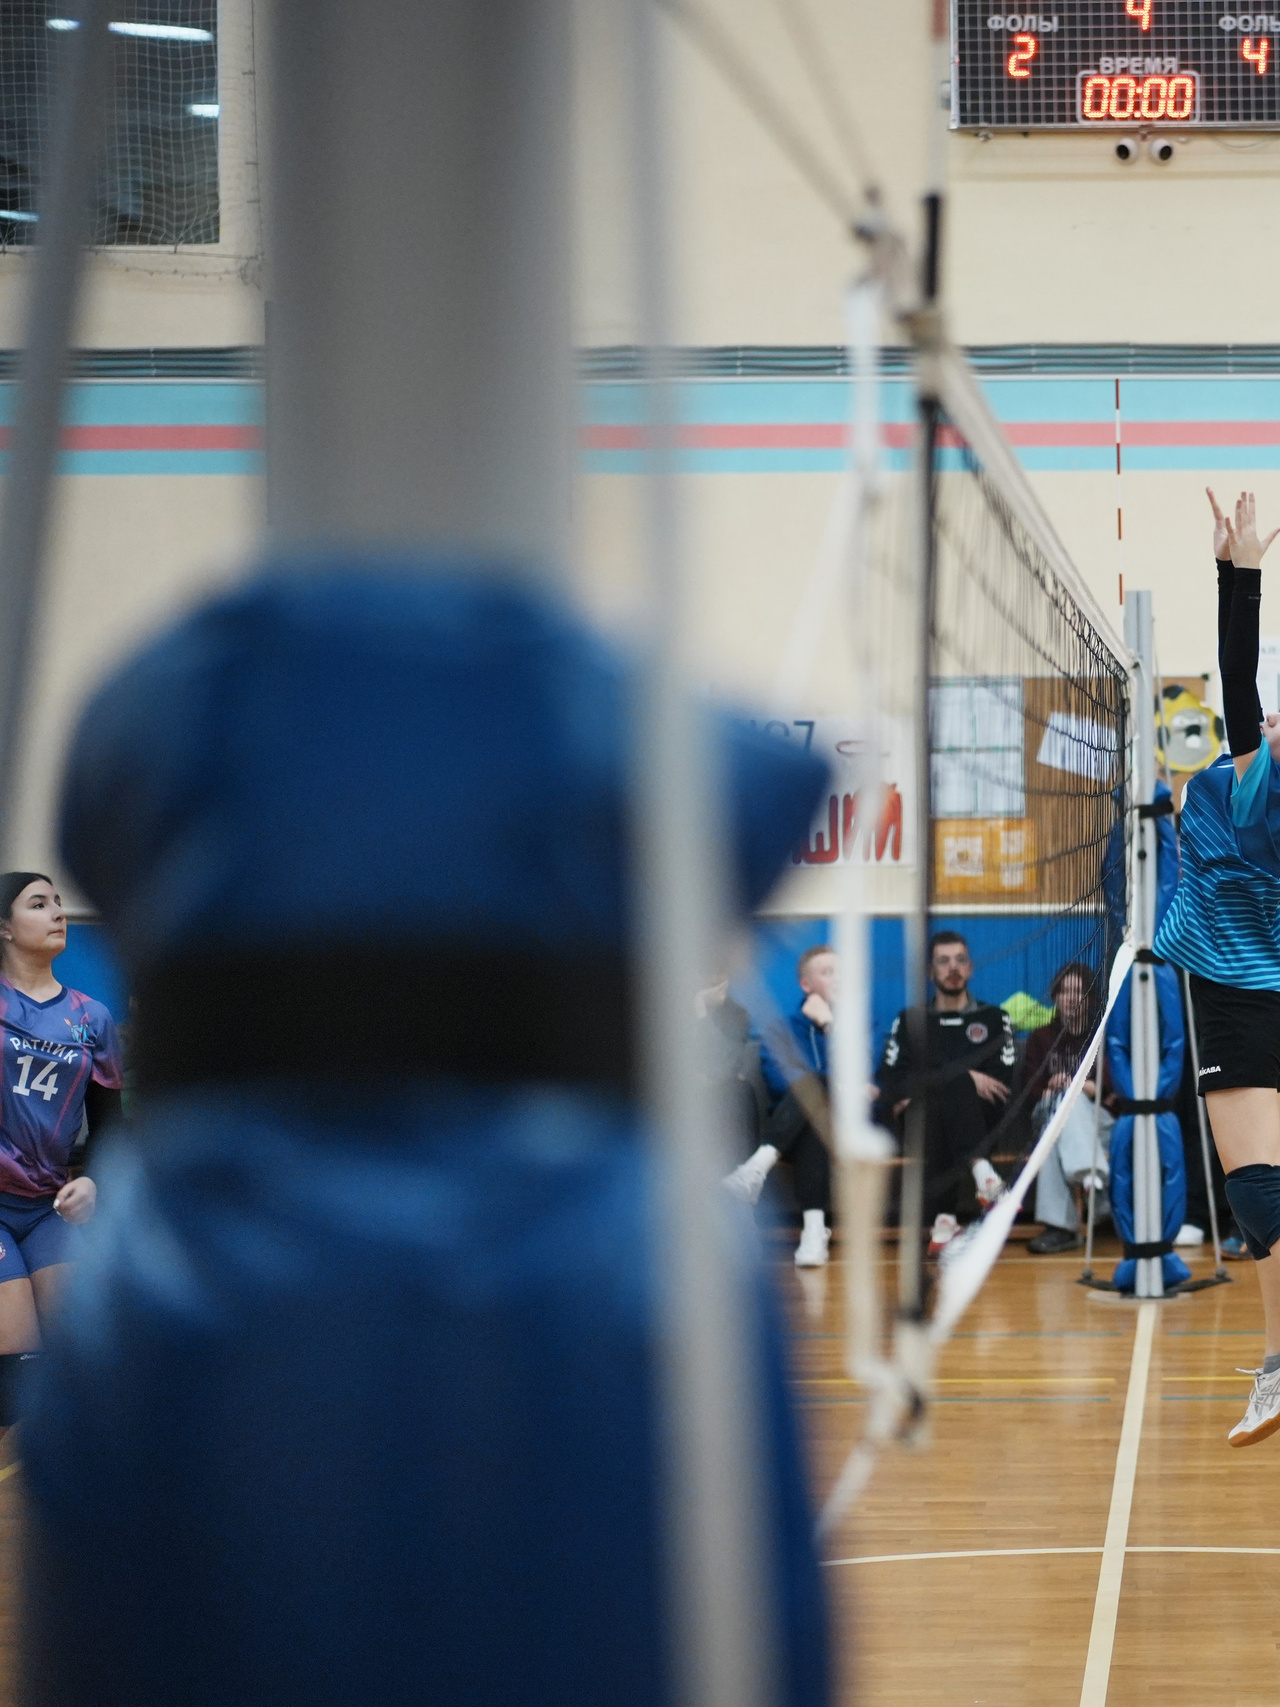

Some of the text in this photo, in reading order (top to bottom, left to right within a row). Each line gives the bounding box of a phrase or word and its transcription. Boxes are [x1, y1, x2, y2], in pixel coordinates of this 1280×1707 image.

[987, 15, 1058, 33] ФОЛЫ
[1126, 0, 1150, 30] 4
[1008, 33, 1037, 78] 2
[1099, 56, 1178, 74] ВРЕМЯ
[1241, 38, 1269, 75] 4
[1083, 77, 1194, 118] 00:00
[9, 1036, 79, 1065] РАТНИК
[12, 1054, 59, 1102] 14
